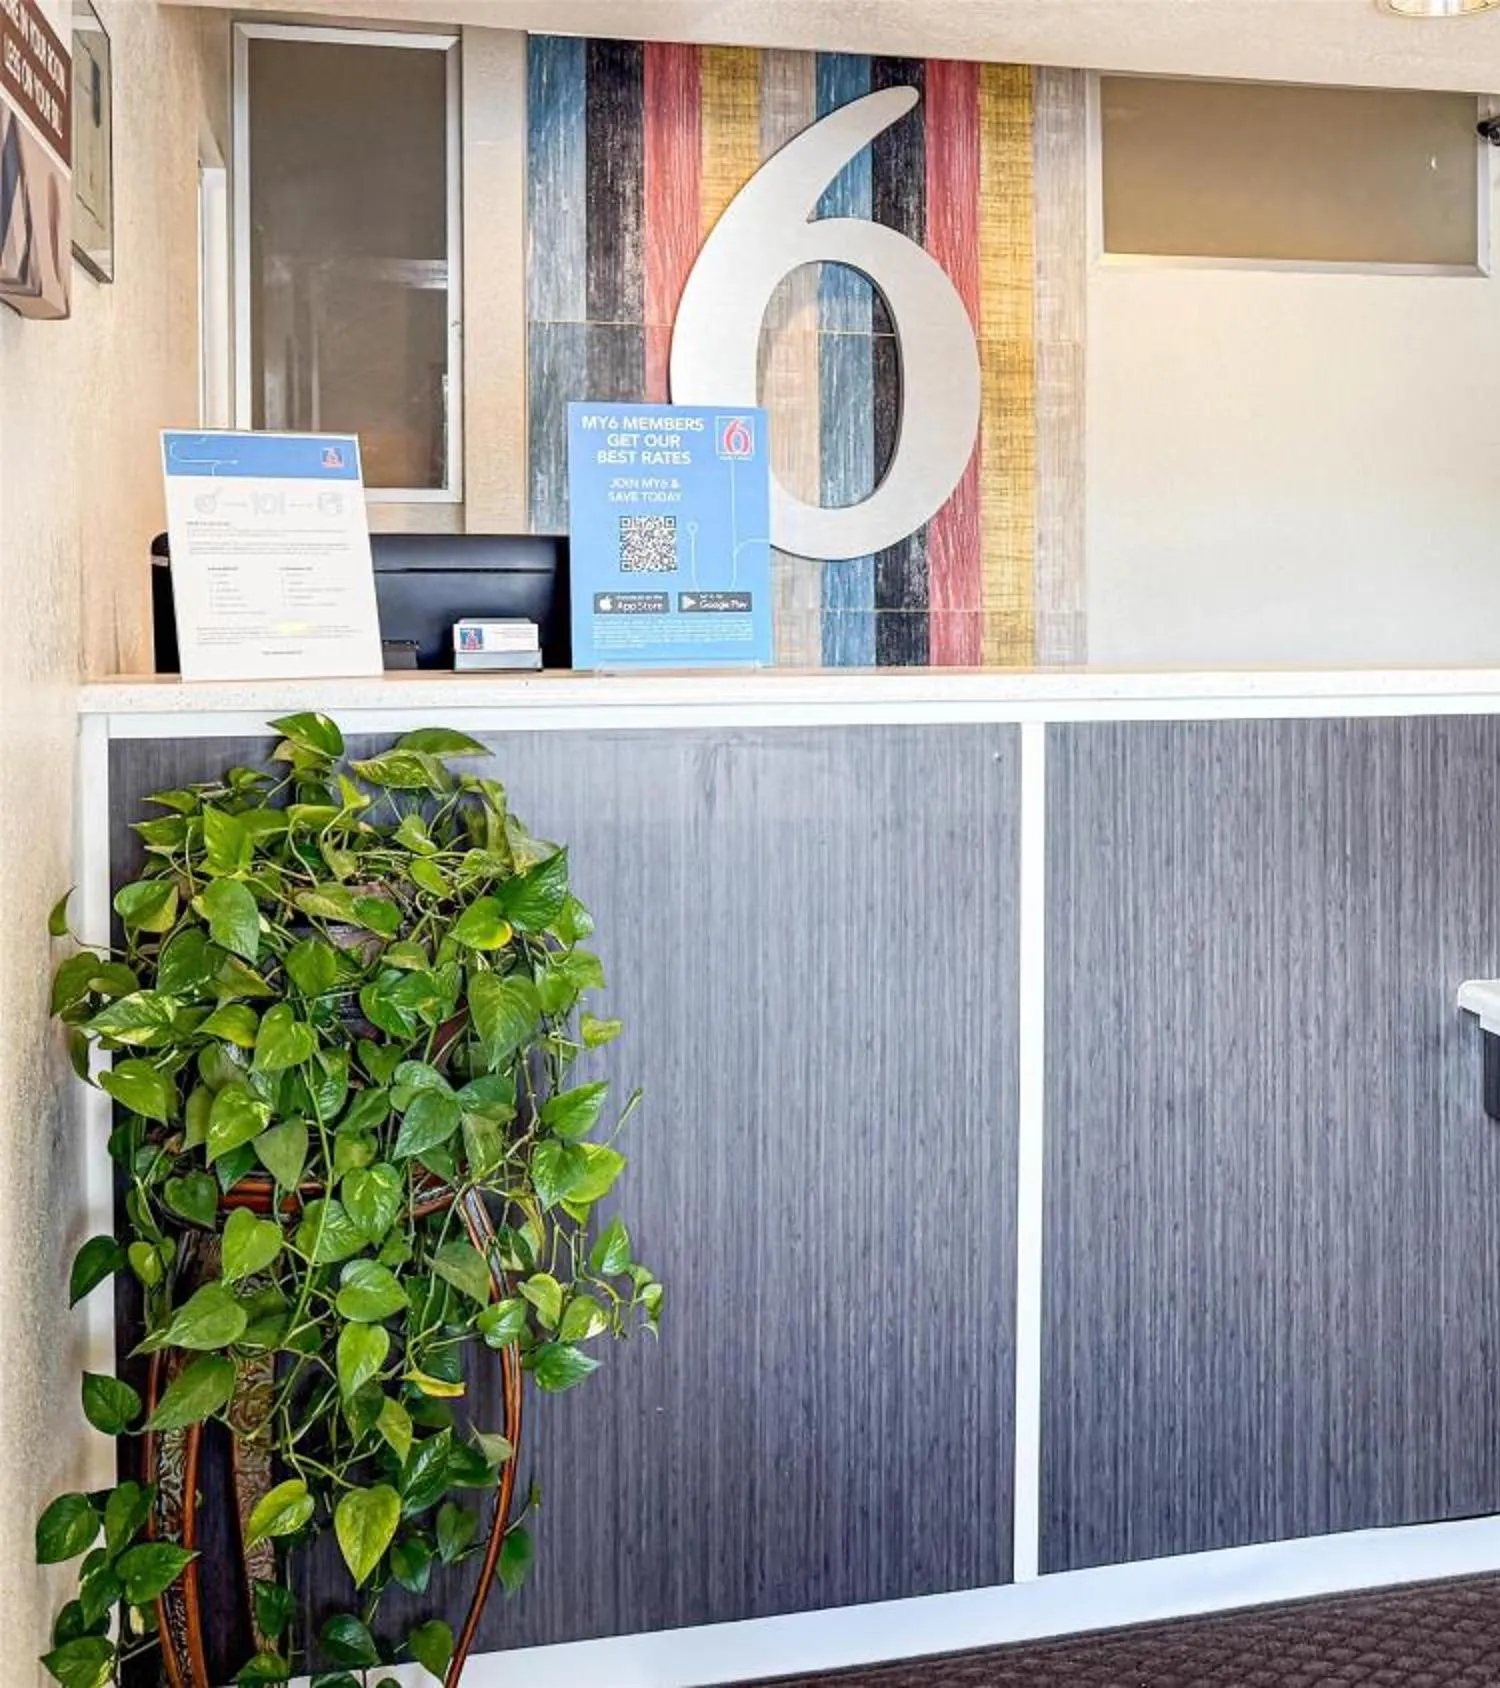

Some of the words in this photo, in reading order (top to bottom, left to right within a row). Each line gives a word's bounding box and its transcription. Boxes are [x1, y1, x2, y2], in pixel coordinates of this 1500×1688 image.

[669, 85, 981, 561] 6
[581, 415, 619, 430] MY6
[623, 416, 705, 432] MEMBERS
[607, 433, 640, 447] GET
[644, 434, 681, 447] OUR
[597, 450, 638, 464] BEST
[641, 450, 691, 465] RATES
[609, 478, 640, 490] JOIN
[641, 477, 666, 489] MY6
[669, 478, 680, 489] &
[608, 491, 640, 503] SAVE
[641, 491, 682, 503] TODAY
[638, 601, 663, 610] Store
